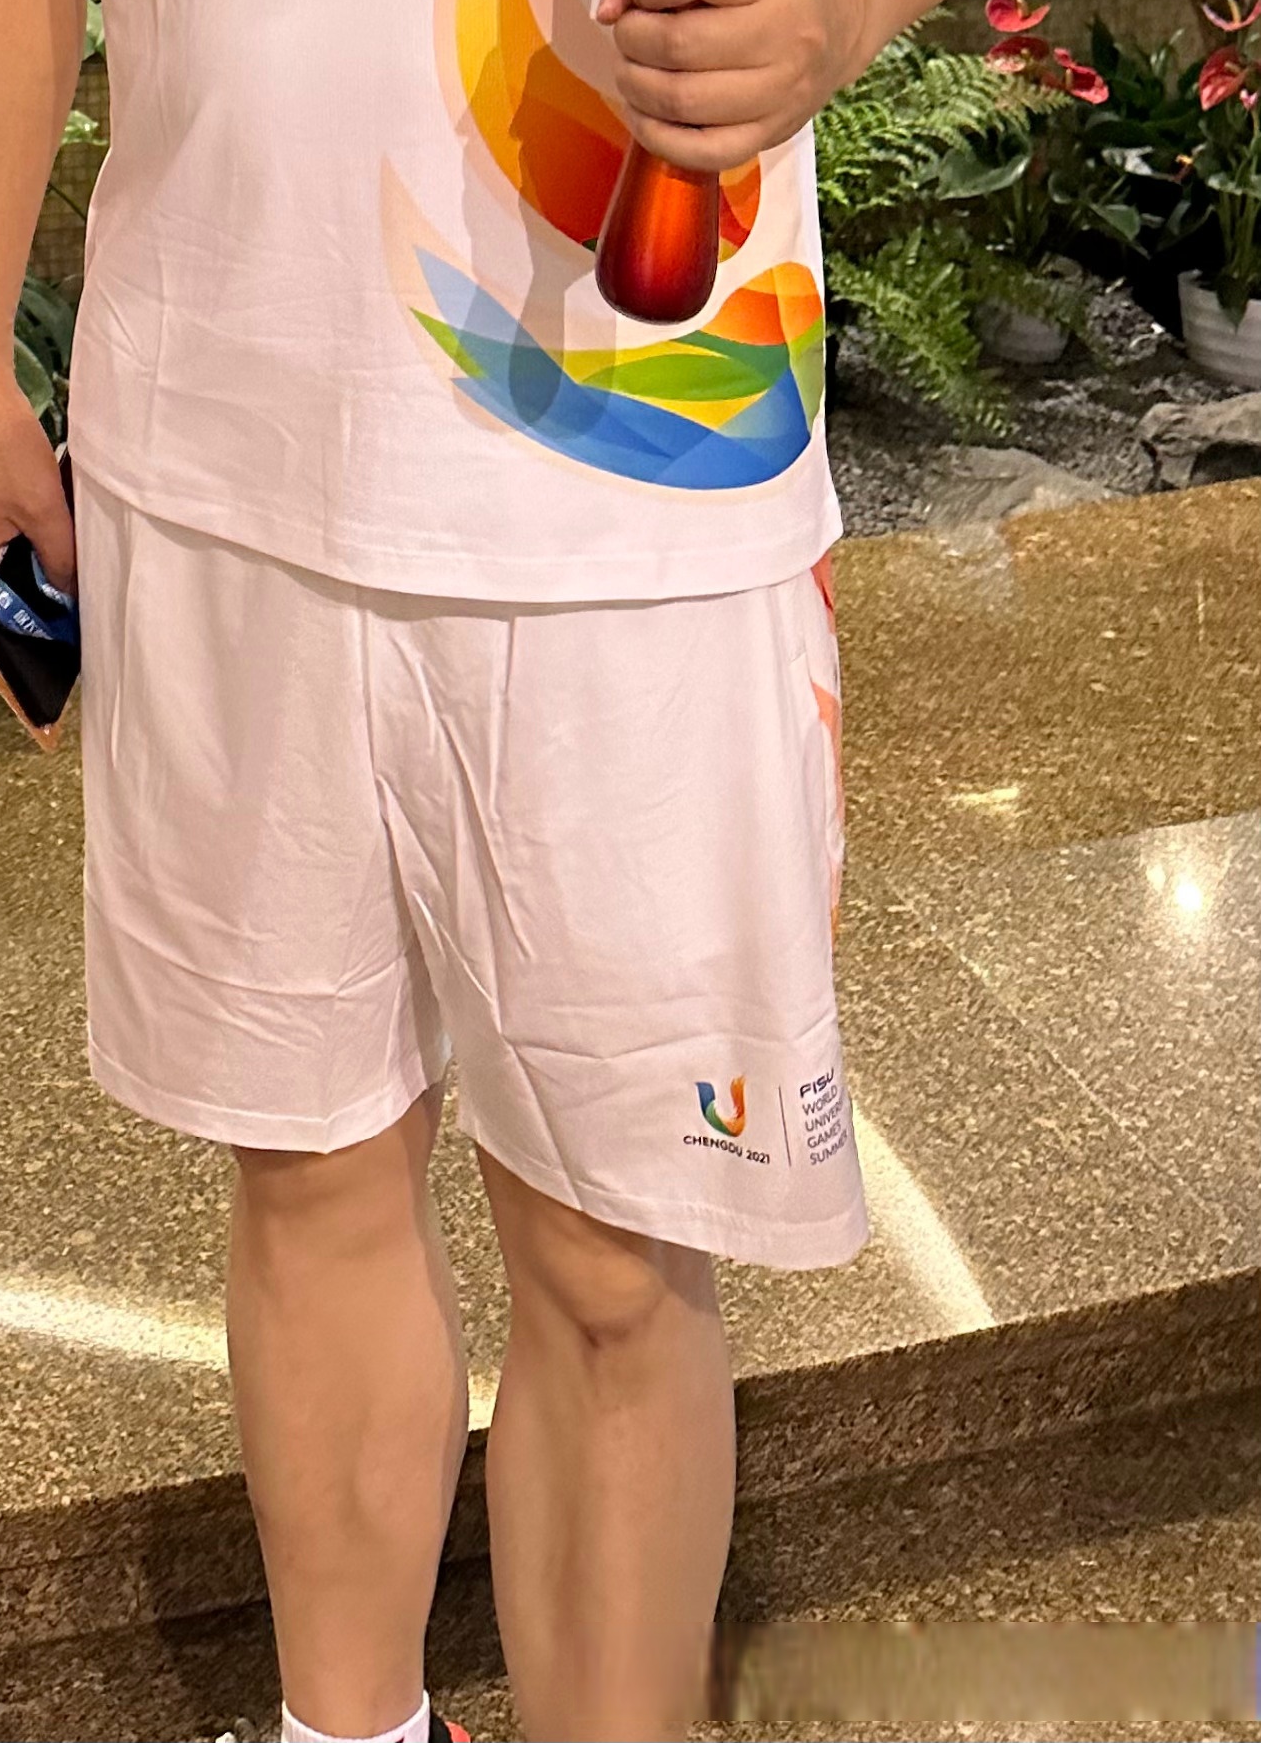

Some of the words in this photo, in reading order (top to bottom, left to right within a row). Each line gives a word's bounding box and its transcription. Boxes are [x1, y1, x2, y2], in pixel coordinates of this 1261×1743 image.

[800, 1067, 834, 1098] FISU
[802, 1085, 837, 1116] WORLD
[807, 1119, 841, 1148] GAMES
[683, 1135, 742, 1157] CHENGDU
[746, 1149, 771, 1164] 2021
